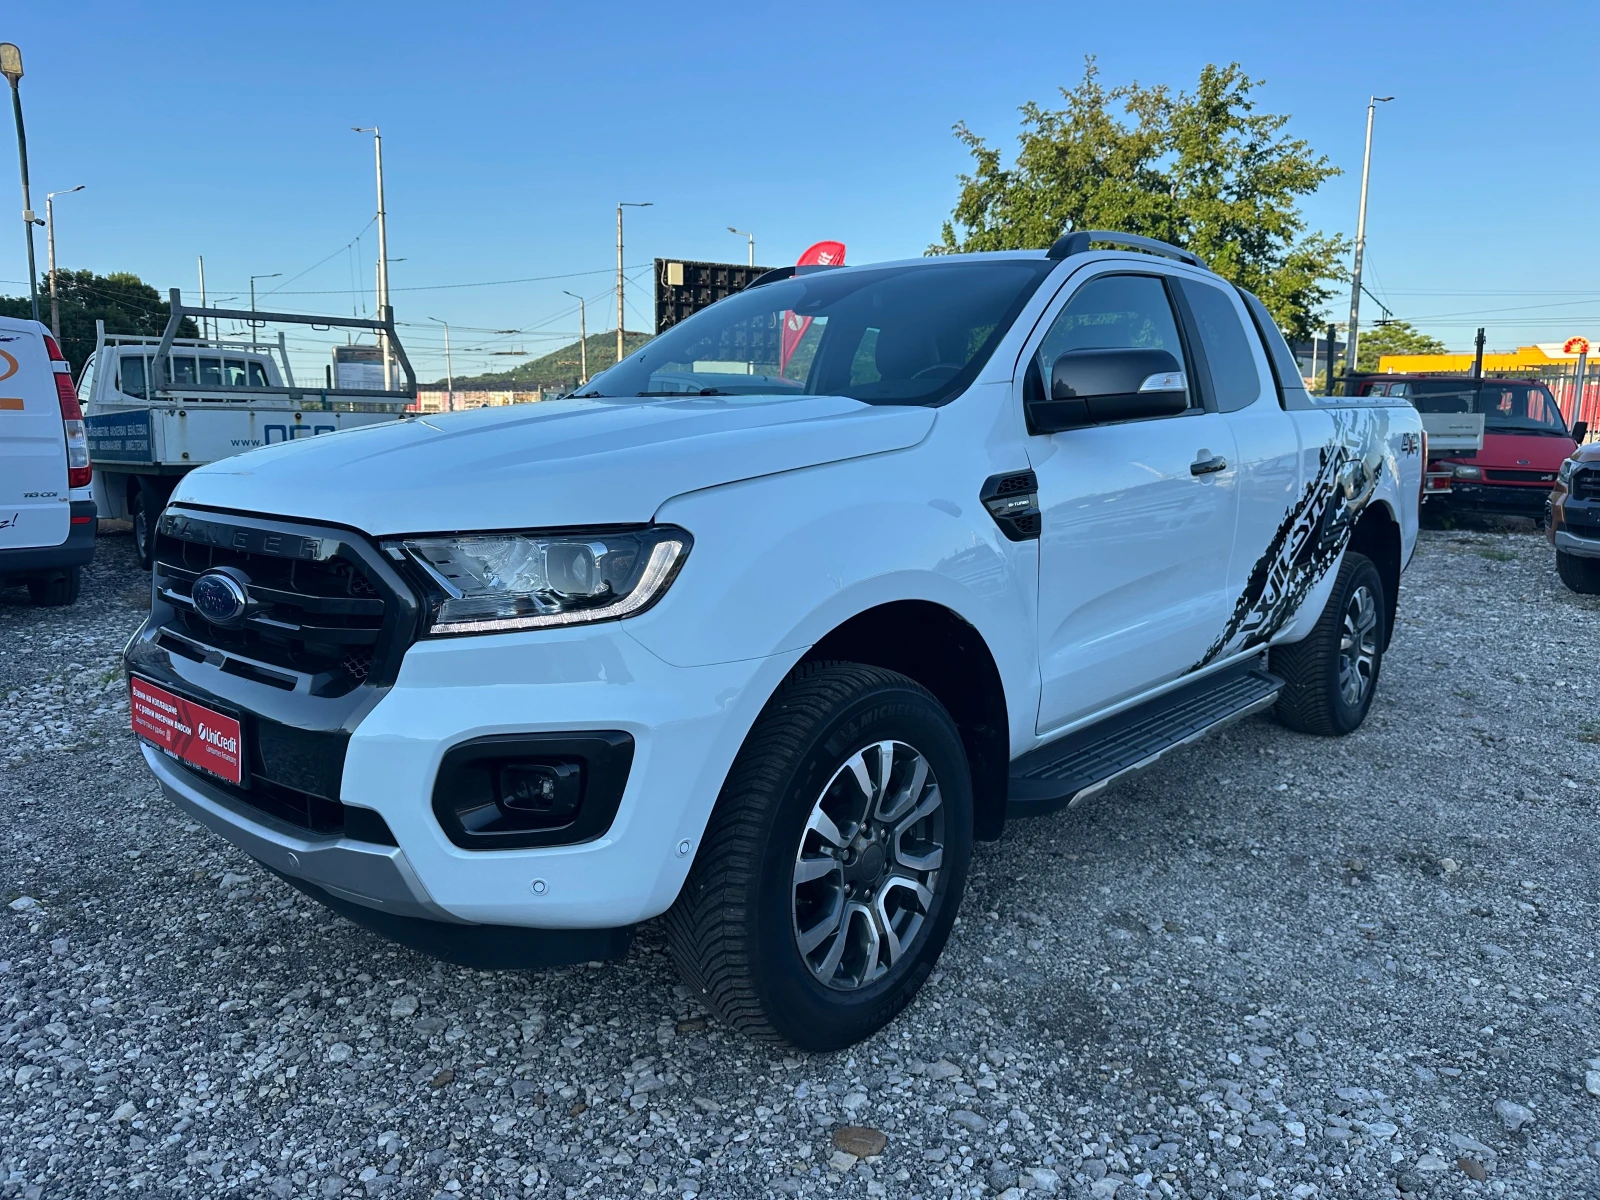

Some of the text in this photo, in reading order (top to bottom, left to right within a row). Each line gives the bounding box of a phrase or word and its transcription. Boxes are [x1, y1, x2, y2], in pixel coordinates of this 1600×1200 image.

[161, 517, 323, 561] RANGER
[860, 703, 924, 729] MICHELIN
[206, 726, 237, 754] UniCredit
